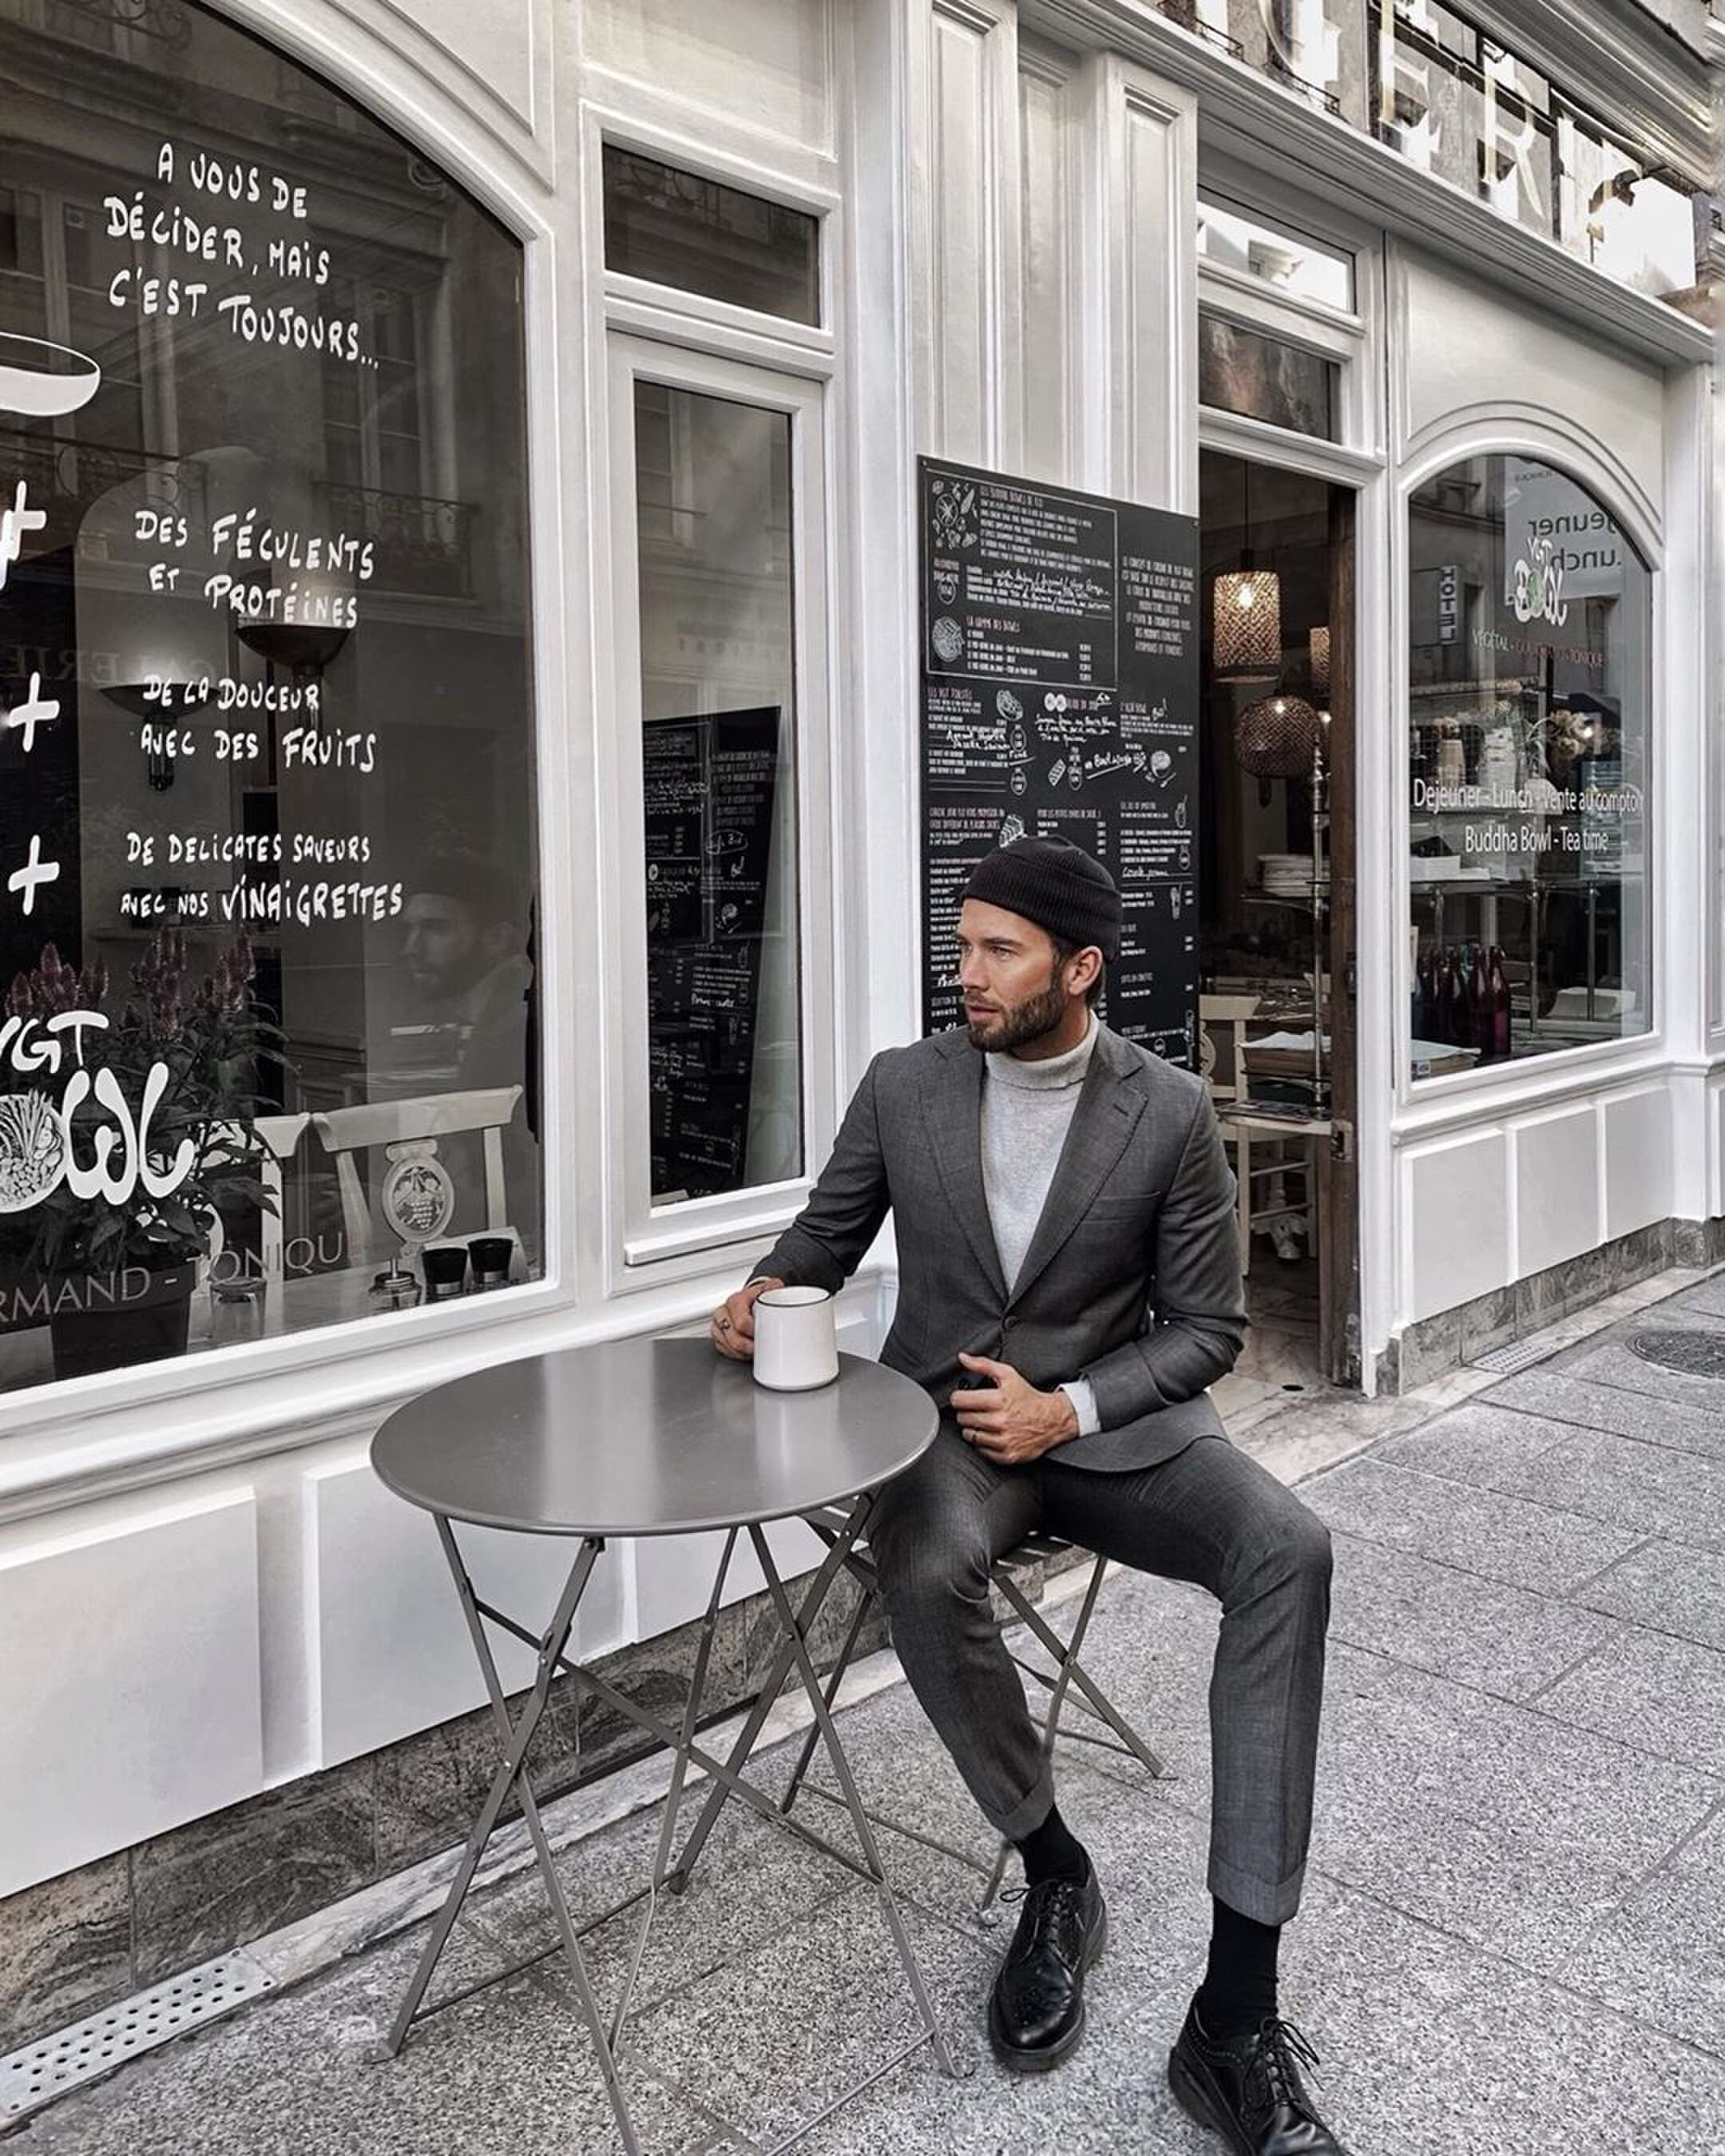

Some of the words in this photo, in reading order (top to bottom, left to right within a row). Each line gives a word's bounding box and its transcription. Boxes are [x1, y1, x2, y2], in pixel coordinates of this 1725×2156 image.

[158, 143, 173, 183] A
[191, 153, 260, 202] VOUS
[272, 176, 307, 218] DE
[109, 266, 208, 317] C'EST
[135, 510, 188, 547] DES
[212, 508, 375, 581] FÉCULENTS
[149, 563, 180, 591] ET
[143, 675, 172, 707] DE
[184, 676, 208, 704] LA
[217, 677, 319, 711] DOUCEUR
[141, 723, 196, 758] AVEC
[214, 730, 259, 760] DES
[127, 832, 154, 866] DE
[293, 834, 371, 863] SAVEURS
[1465, 825, 1517, 853] Buddha
[1520, 826, 1552, 852] Bowl
[1560, 826, 1581, 851] Tea
[121, 894, 165, 917] AVEC
[178, 892, 208, 917] NOS
